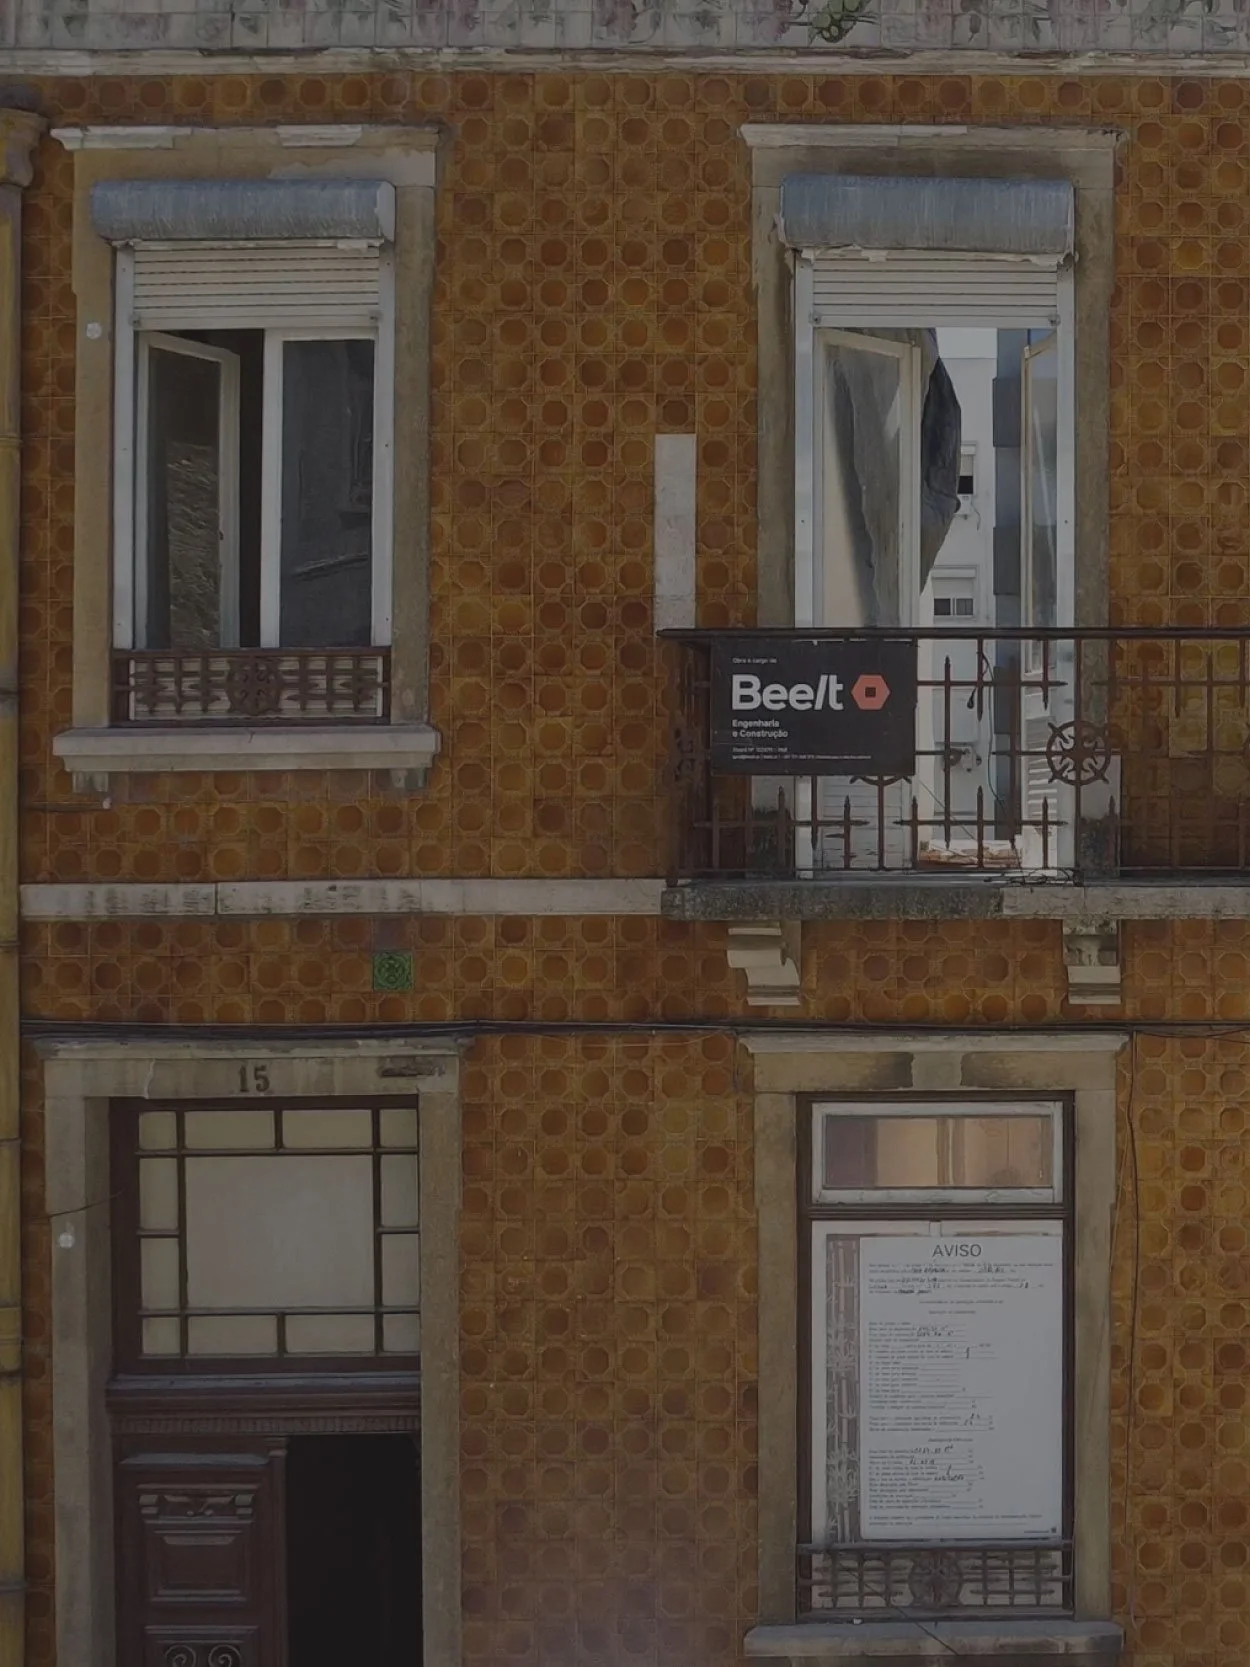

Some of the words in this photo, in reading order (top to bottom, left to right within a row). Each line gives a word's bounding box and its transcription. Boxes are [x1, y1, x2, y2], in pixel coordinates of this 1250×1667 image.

[732, 719, 780, 729] Engenharia
[740, 729, 789, 739] Construção
[239, 1065, 270, 1093] 15
[932, 1243, 983, 1258] AVISO
